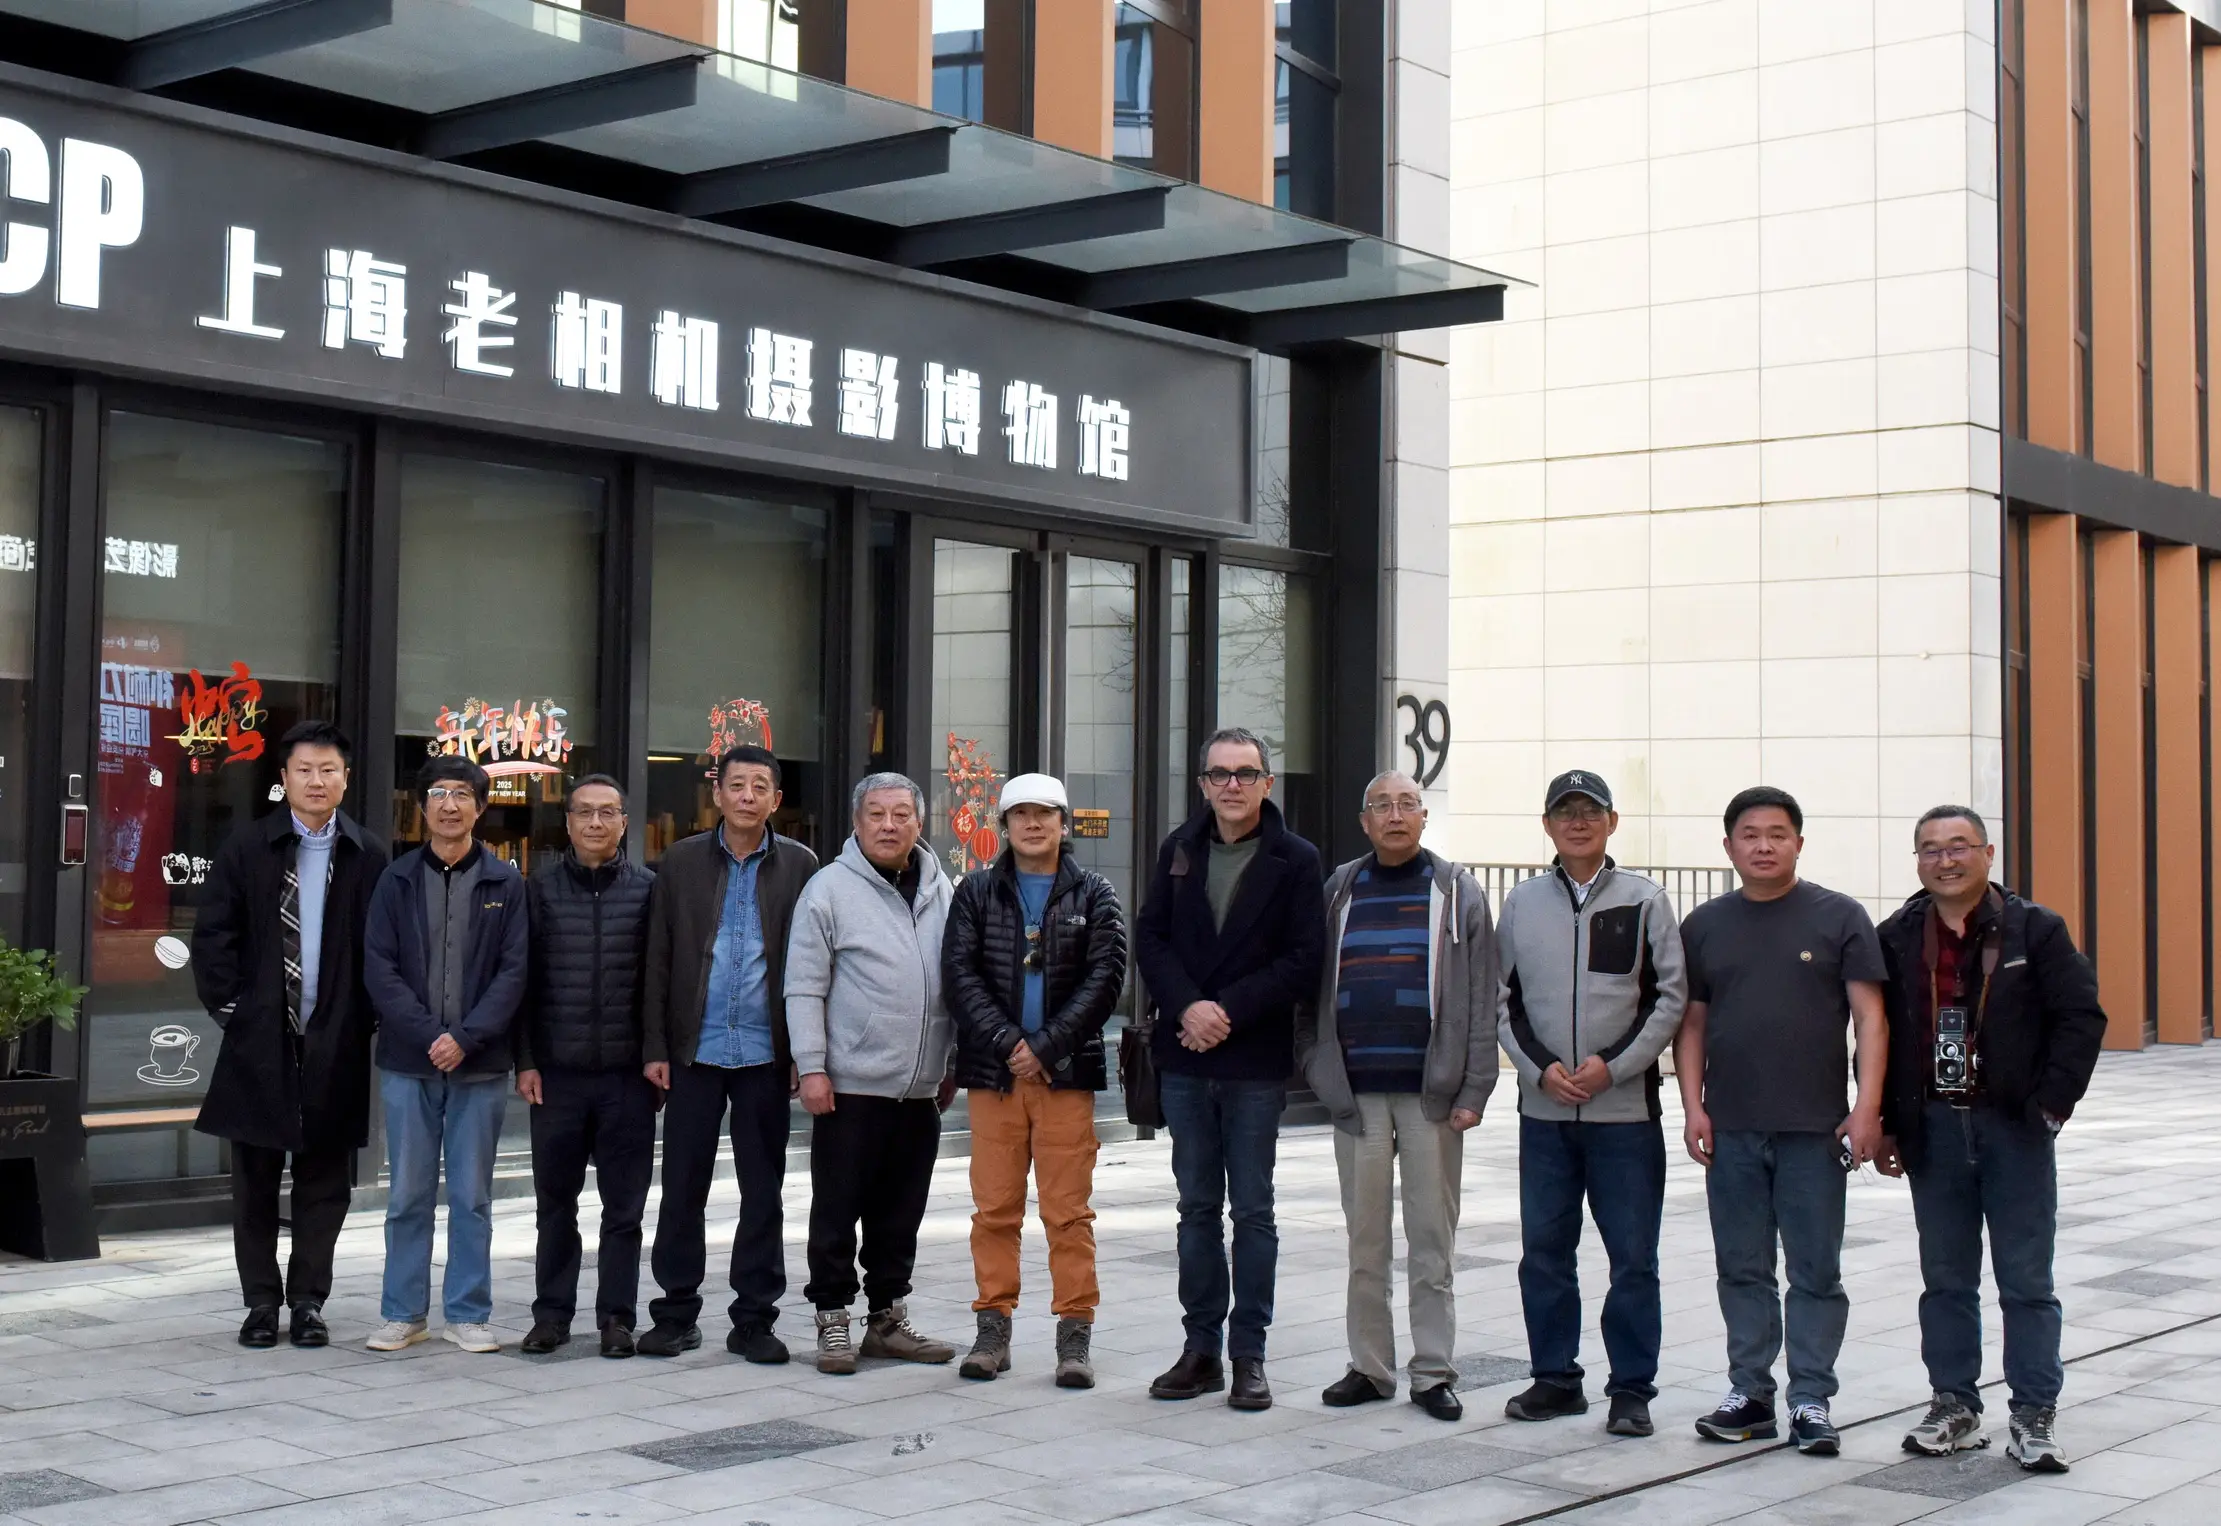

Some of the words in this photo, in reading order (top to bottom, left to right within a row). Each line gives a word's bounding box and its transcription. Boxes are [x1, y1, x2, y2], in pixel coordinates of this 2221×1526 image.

[195, 226, 1130, 482] 上海老相机摄影博物馆
[435, 699, 574, 764] 新年快乐
[1397, 694, 1451, 789] 39
[496, 780, 513, 789] 2025
[1570, 774, 1583, 786] NY
[956, 812, 972, 833] 福
